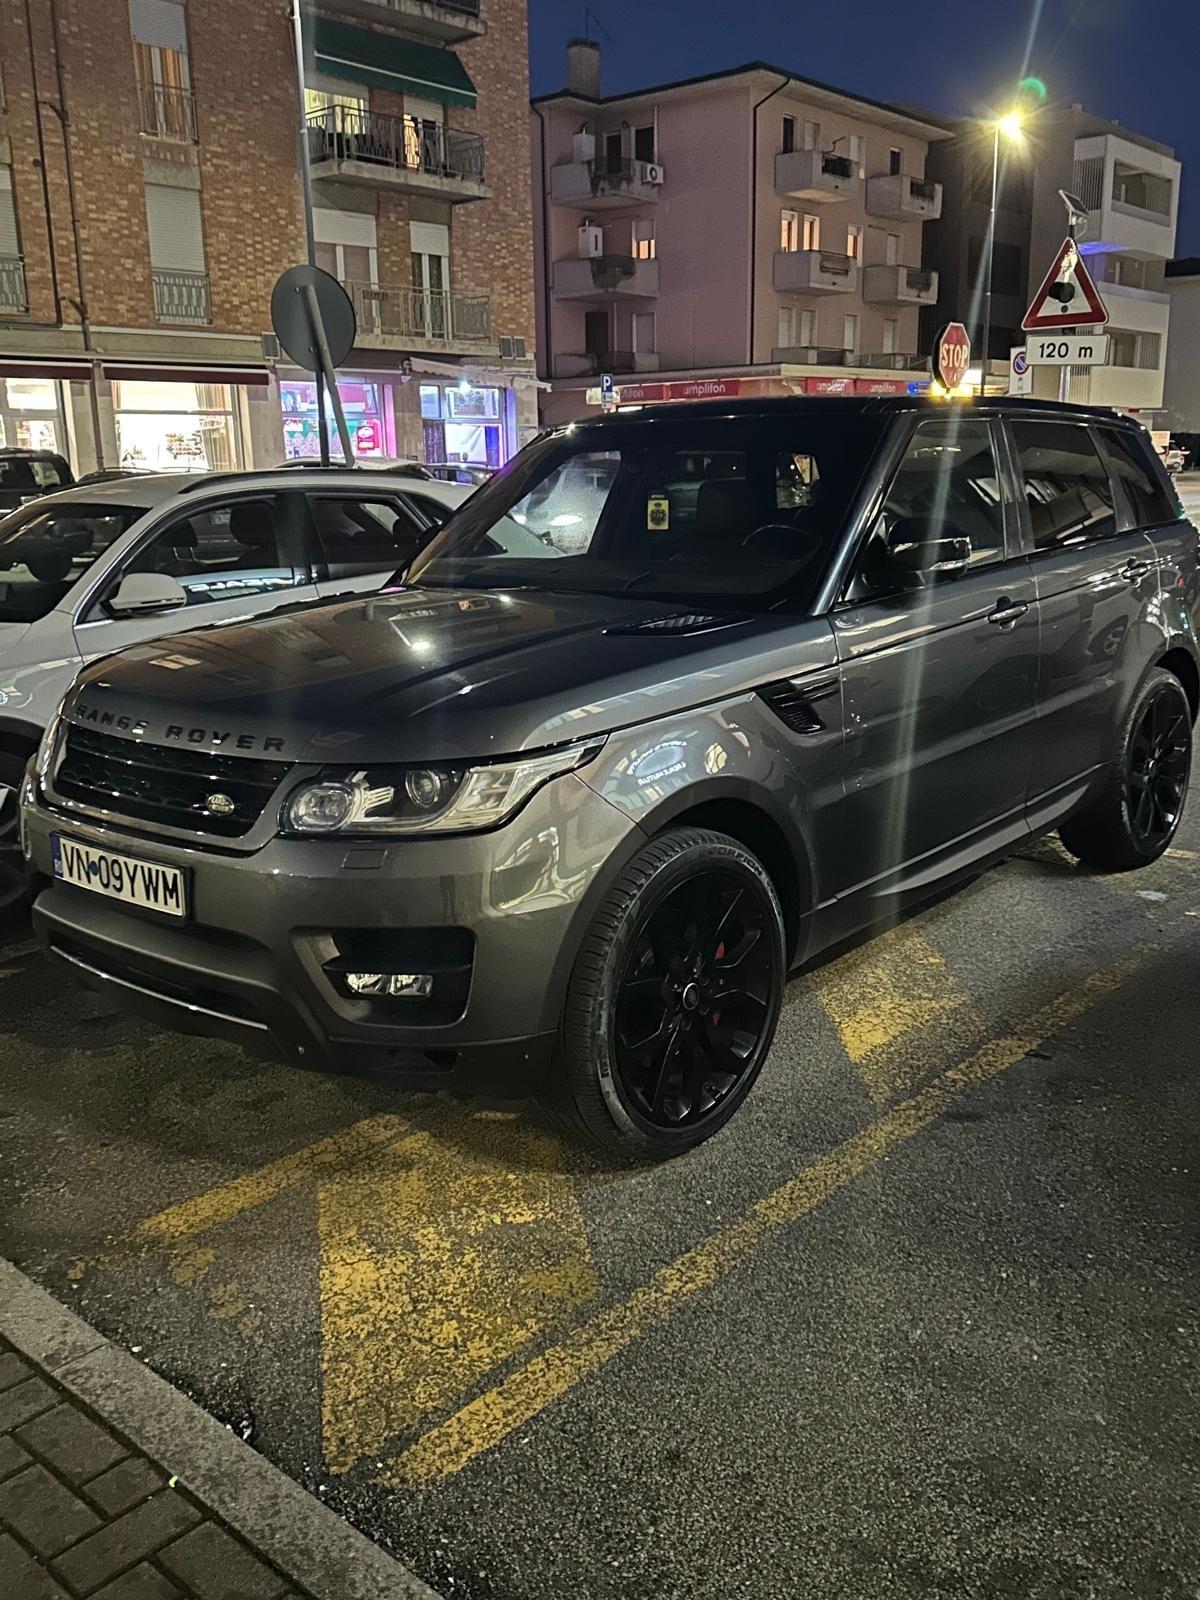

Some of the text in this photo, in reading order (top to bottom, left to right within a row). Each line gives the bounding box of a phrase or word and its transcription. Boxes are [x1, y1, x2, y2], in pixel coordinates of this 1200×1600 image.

[942, 343, 968, 368] STOP
[1039, 342, 1093, 359] 120 m
[603, 376, 612, 391] P
[683, 383, 725, 395] amplifon
[75, 705, 286, 752] RANGE ROVER
